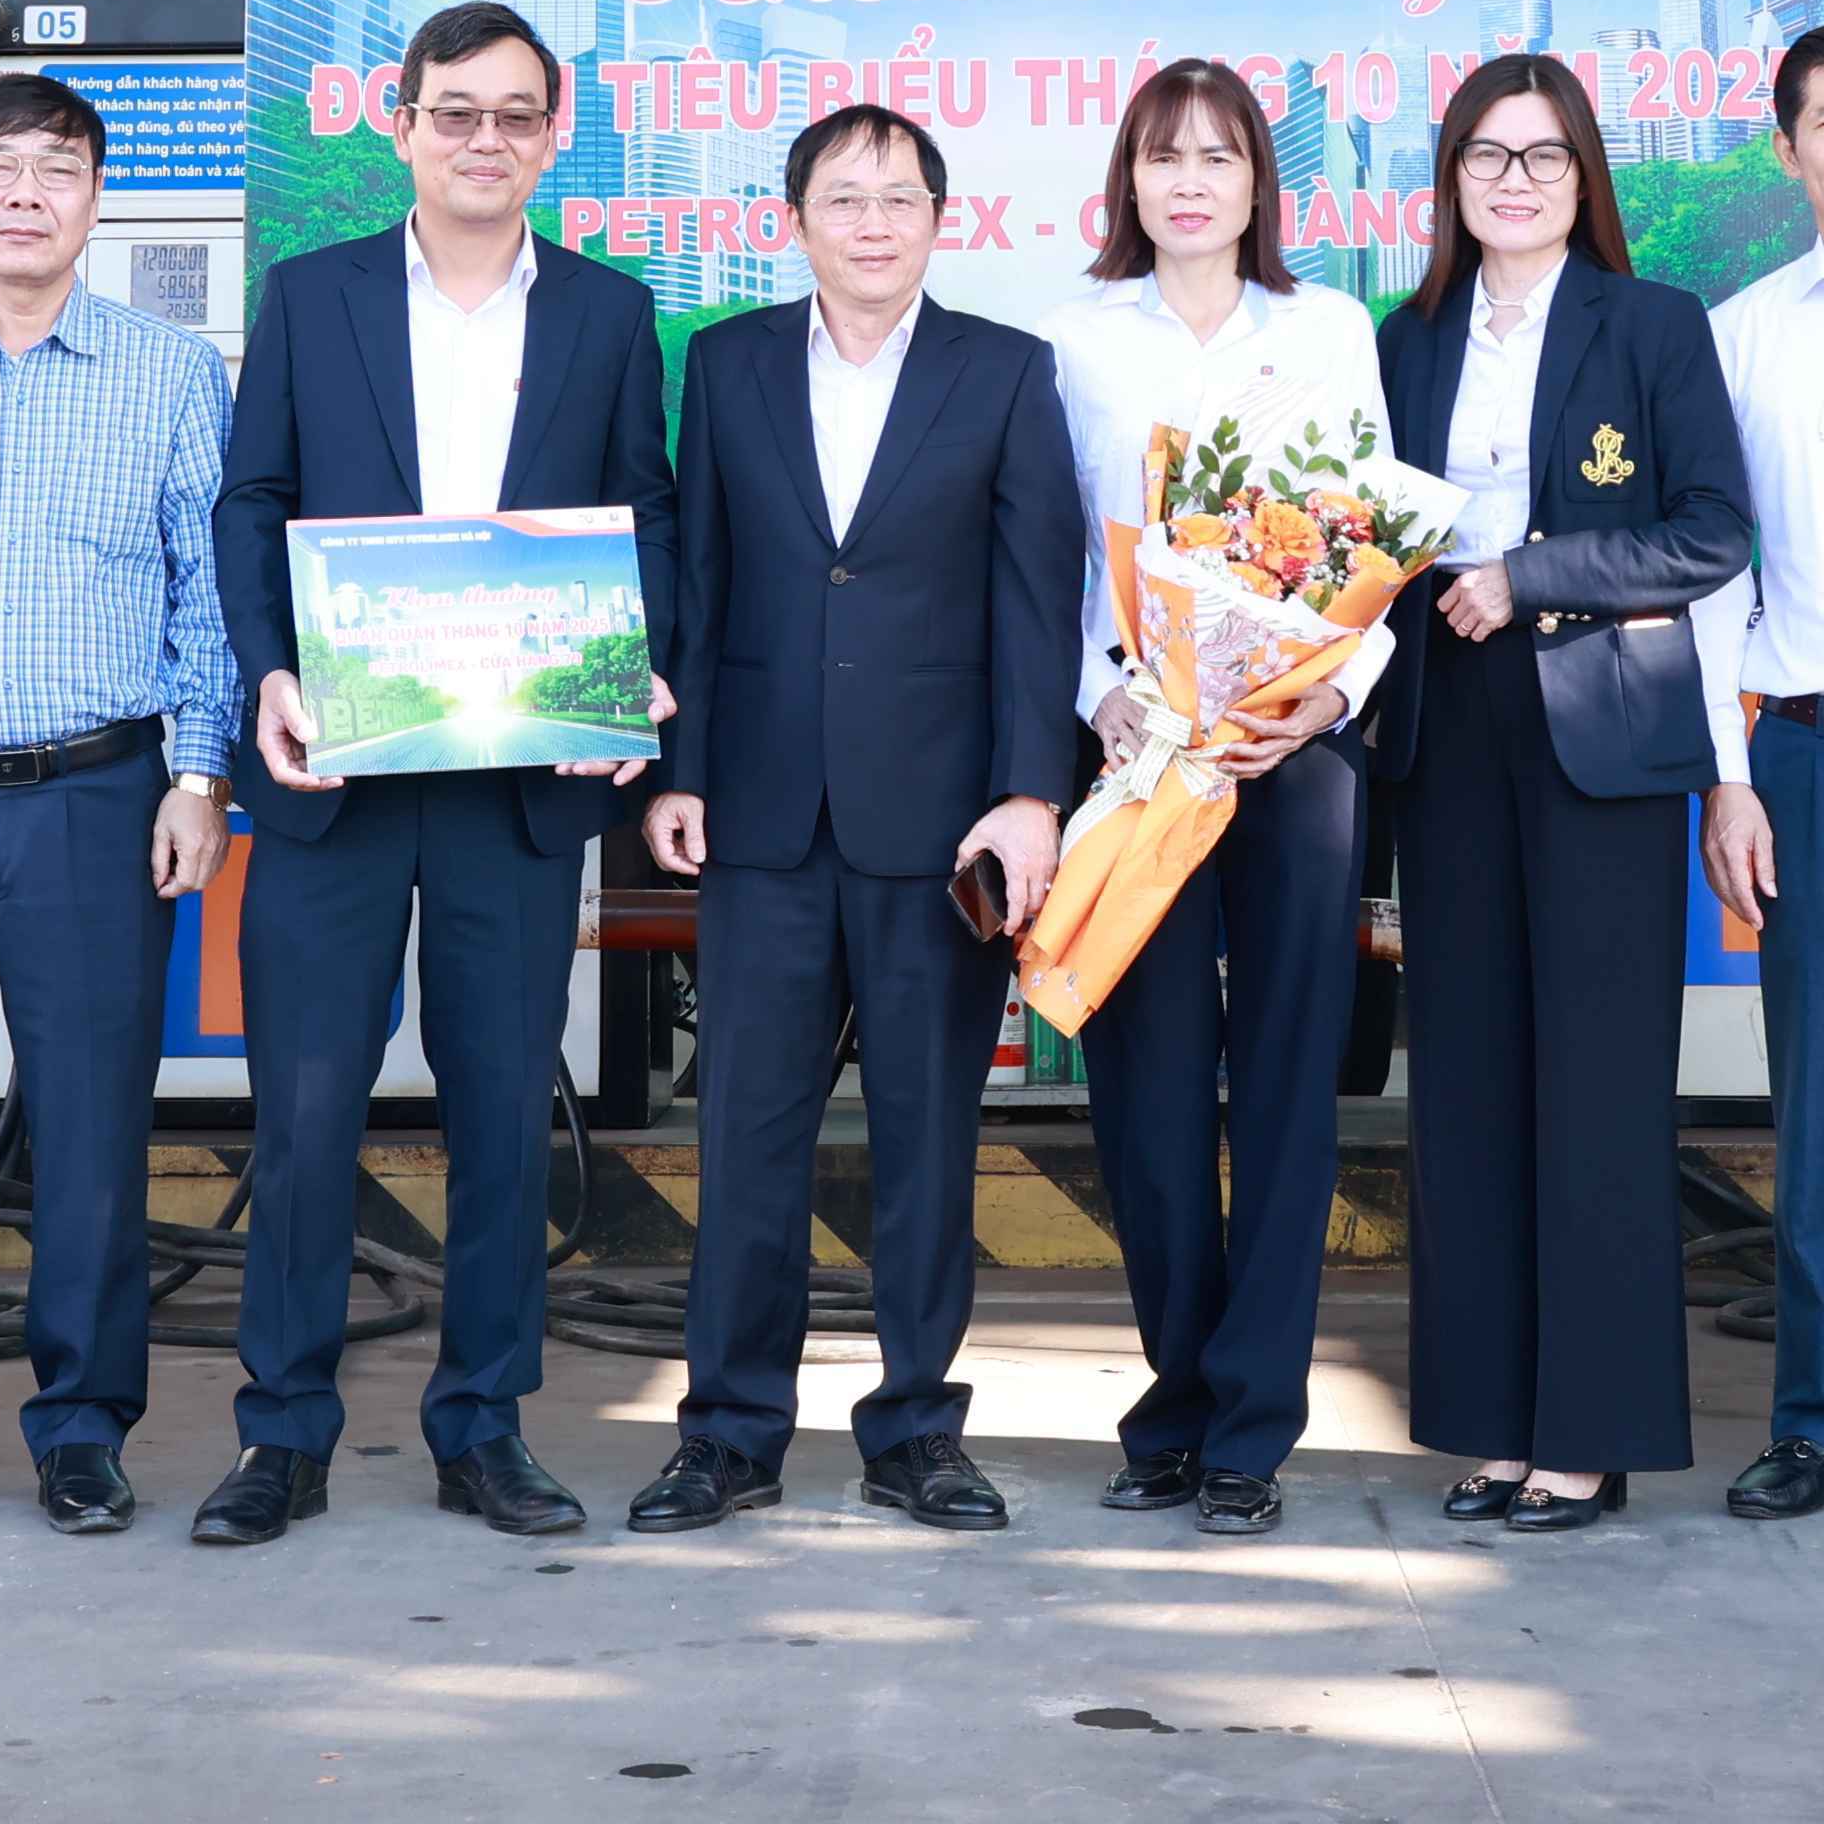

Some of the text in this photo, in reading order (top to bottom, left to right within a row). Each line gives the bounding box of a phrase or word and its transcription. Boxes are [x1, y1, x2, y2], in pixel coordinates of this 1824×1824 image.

[37, 10, 77, 39] 05
[66, 75, 113, 93] Hướng
[116, 74, 140, 90] dẫn
[143, 75, 183, 90] khách
[185, 77, 219, 92] hàng
[599, 45, 780, 134] TIÊU
[807, 22, 988, 129] BIỂU
[1310, 49, 1398, 124] 10
[94, 99, 231, 114] khách hàng xác nhận
[136, 120, 174, 136] đúng,
[176, 120, 194, 133] đủ
[196, 120, 226, 133] theo
[136, 142, 231, 158] hàng xác nhận
[133, 164, 172, 178] thanh
[174, 164, 202, 178] toán
[206, 164, 222, 178] và
